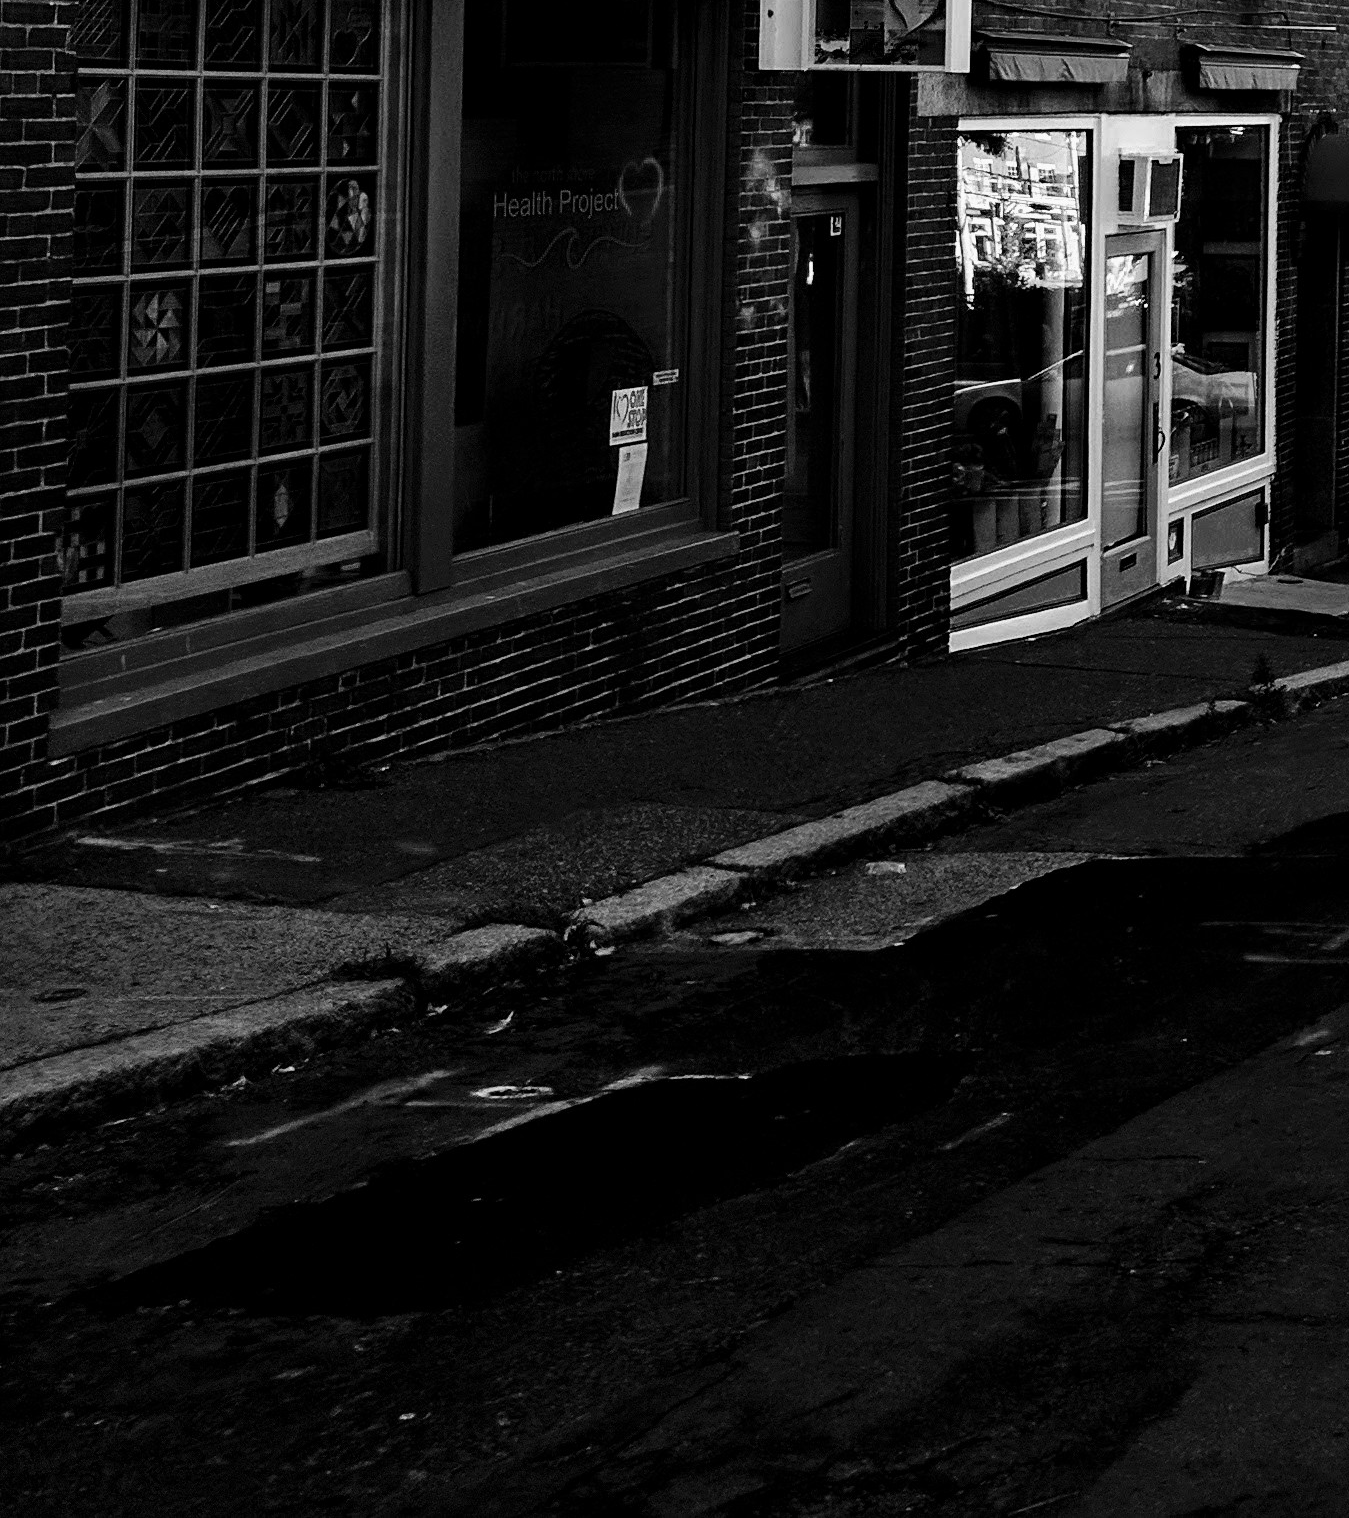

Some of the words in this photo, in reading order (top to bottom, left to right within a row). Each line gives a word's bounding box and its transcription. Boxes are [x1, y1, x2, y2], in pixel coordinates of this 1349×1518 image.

[493, 190, 553, 218] Health
[559, 188, 619, 219] Project
[1153, 351, 1161, 380] 3
[630, 388, 646, 409] ONE
[627, 408, 647, 428] STOP
